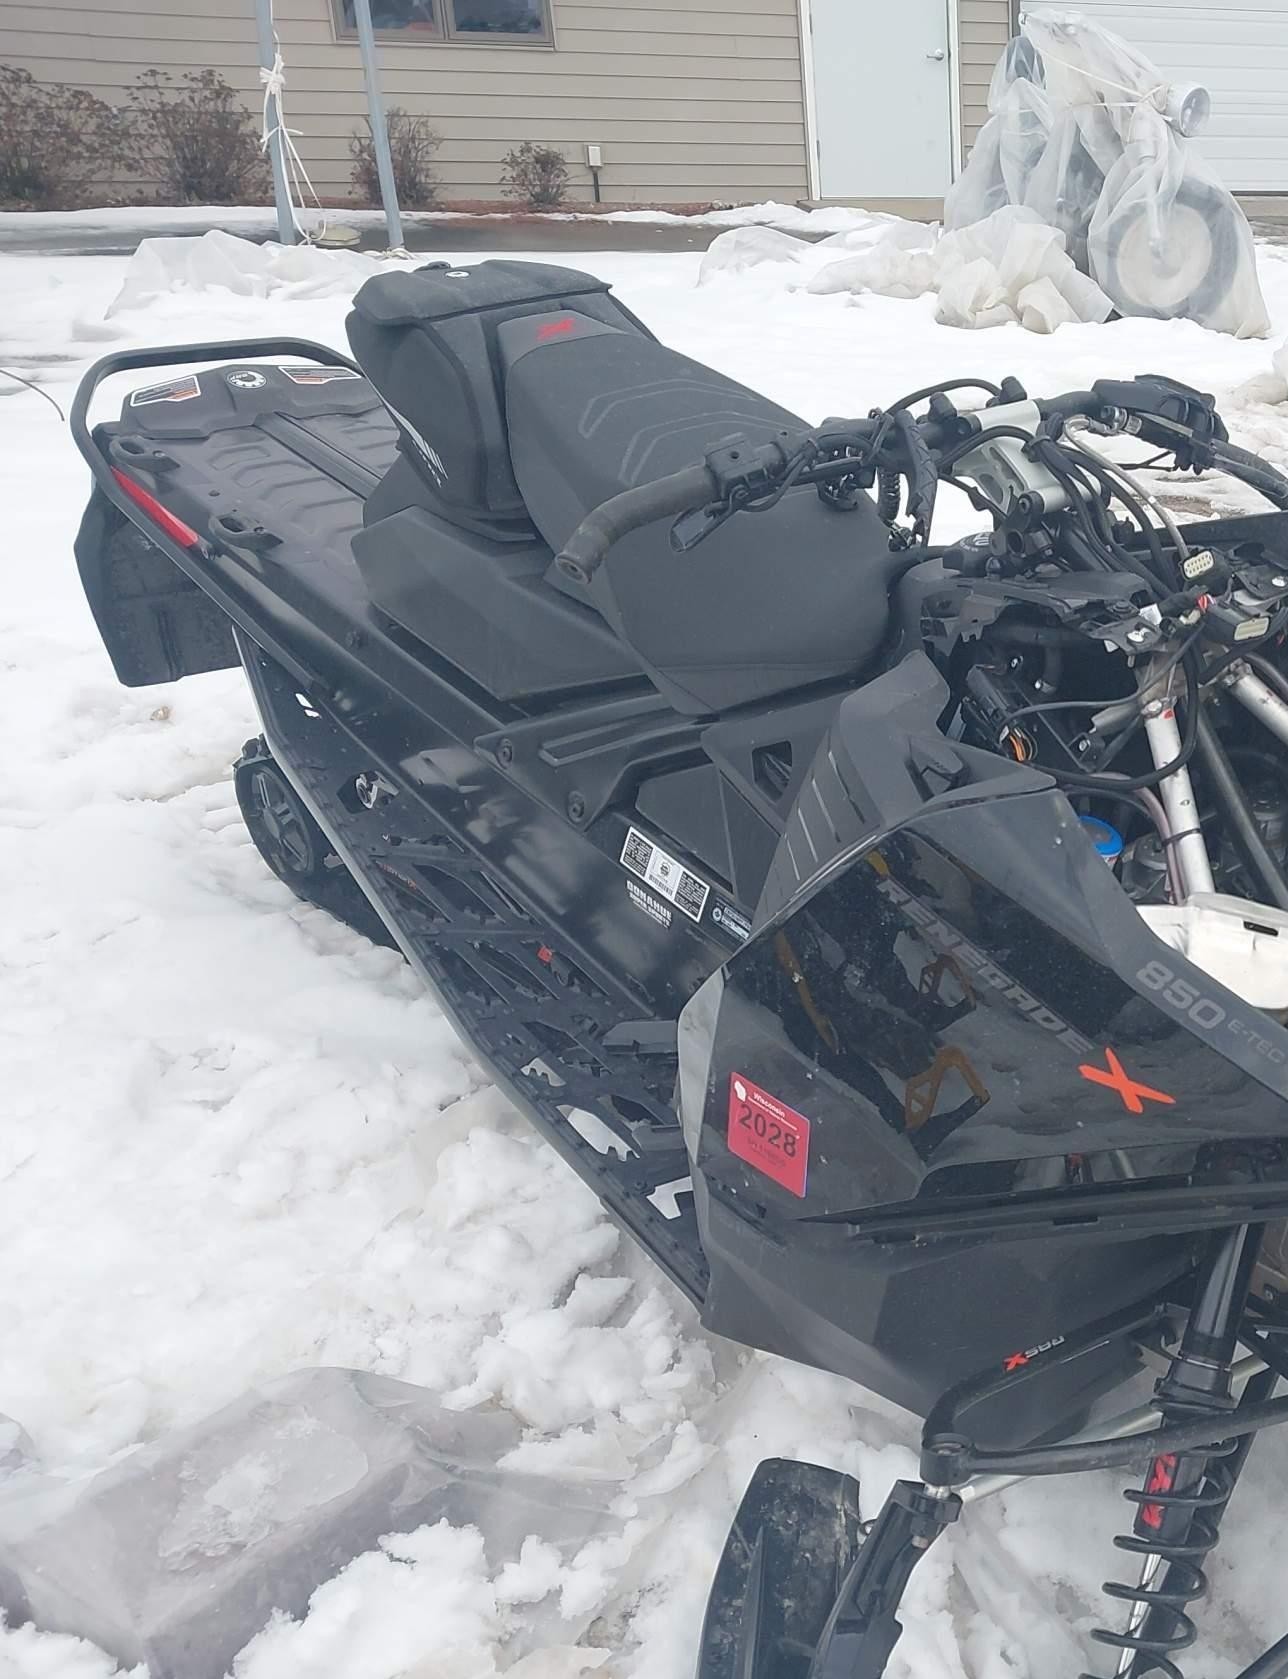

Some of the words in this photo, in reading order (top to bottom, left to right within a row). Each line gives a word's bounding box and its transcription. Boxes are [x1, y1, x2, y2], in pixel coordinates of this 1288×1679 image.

[626, 880, 673, 921] DONAHUE
[876, 879, 1095, 1055] RENEGADE
[1136, 960, 1226, 1029] 850
[1227, 1019, 1285, 1063] E-TEC
[1078, 1047, 1176, 1114] X
[738, 1104, 797, 1158] 2028
